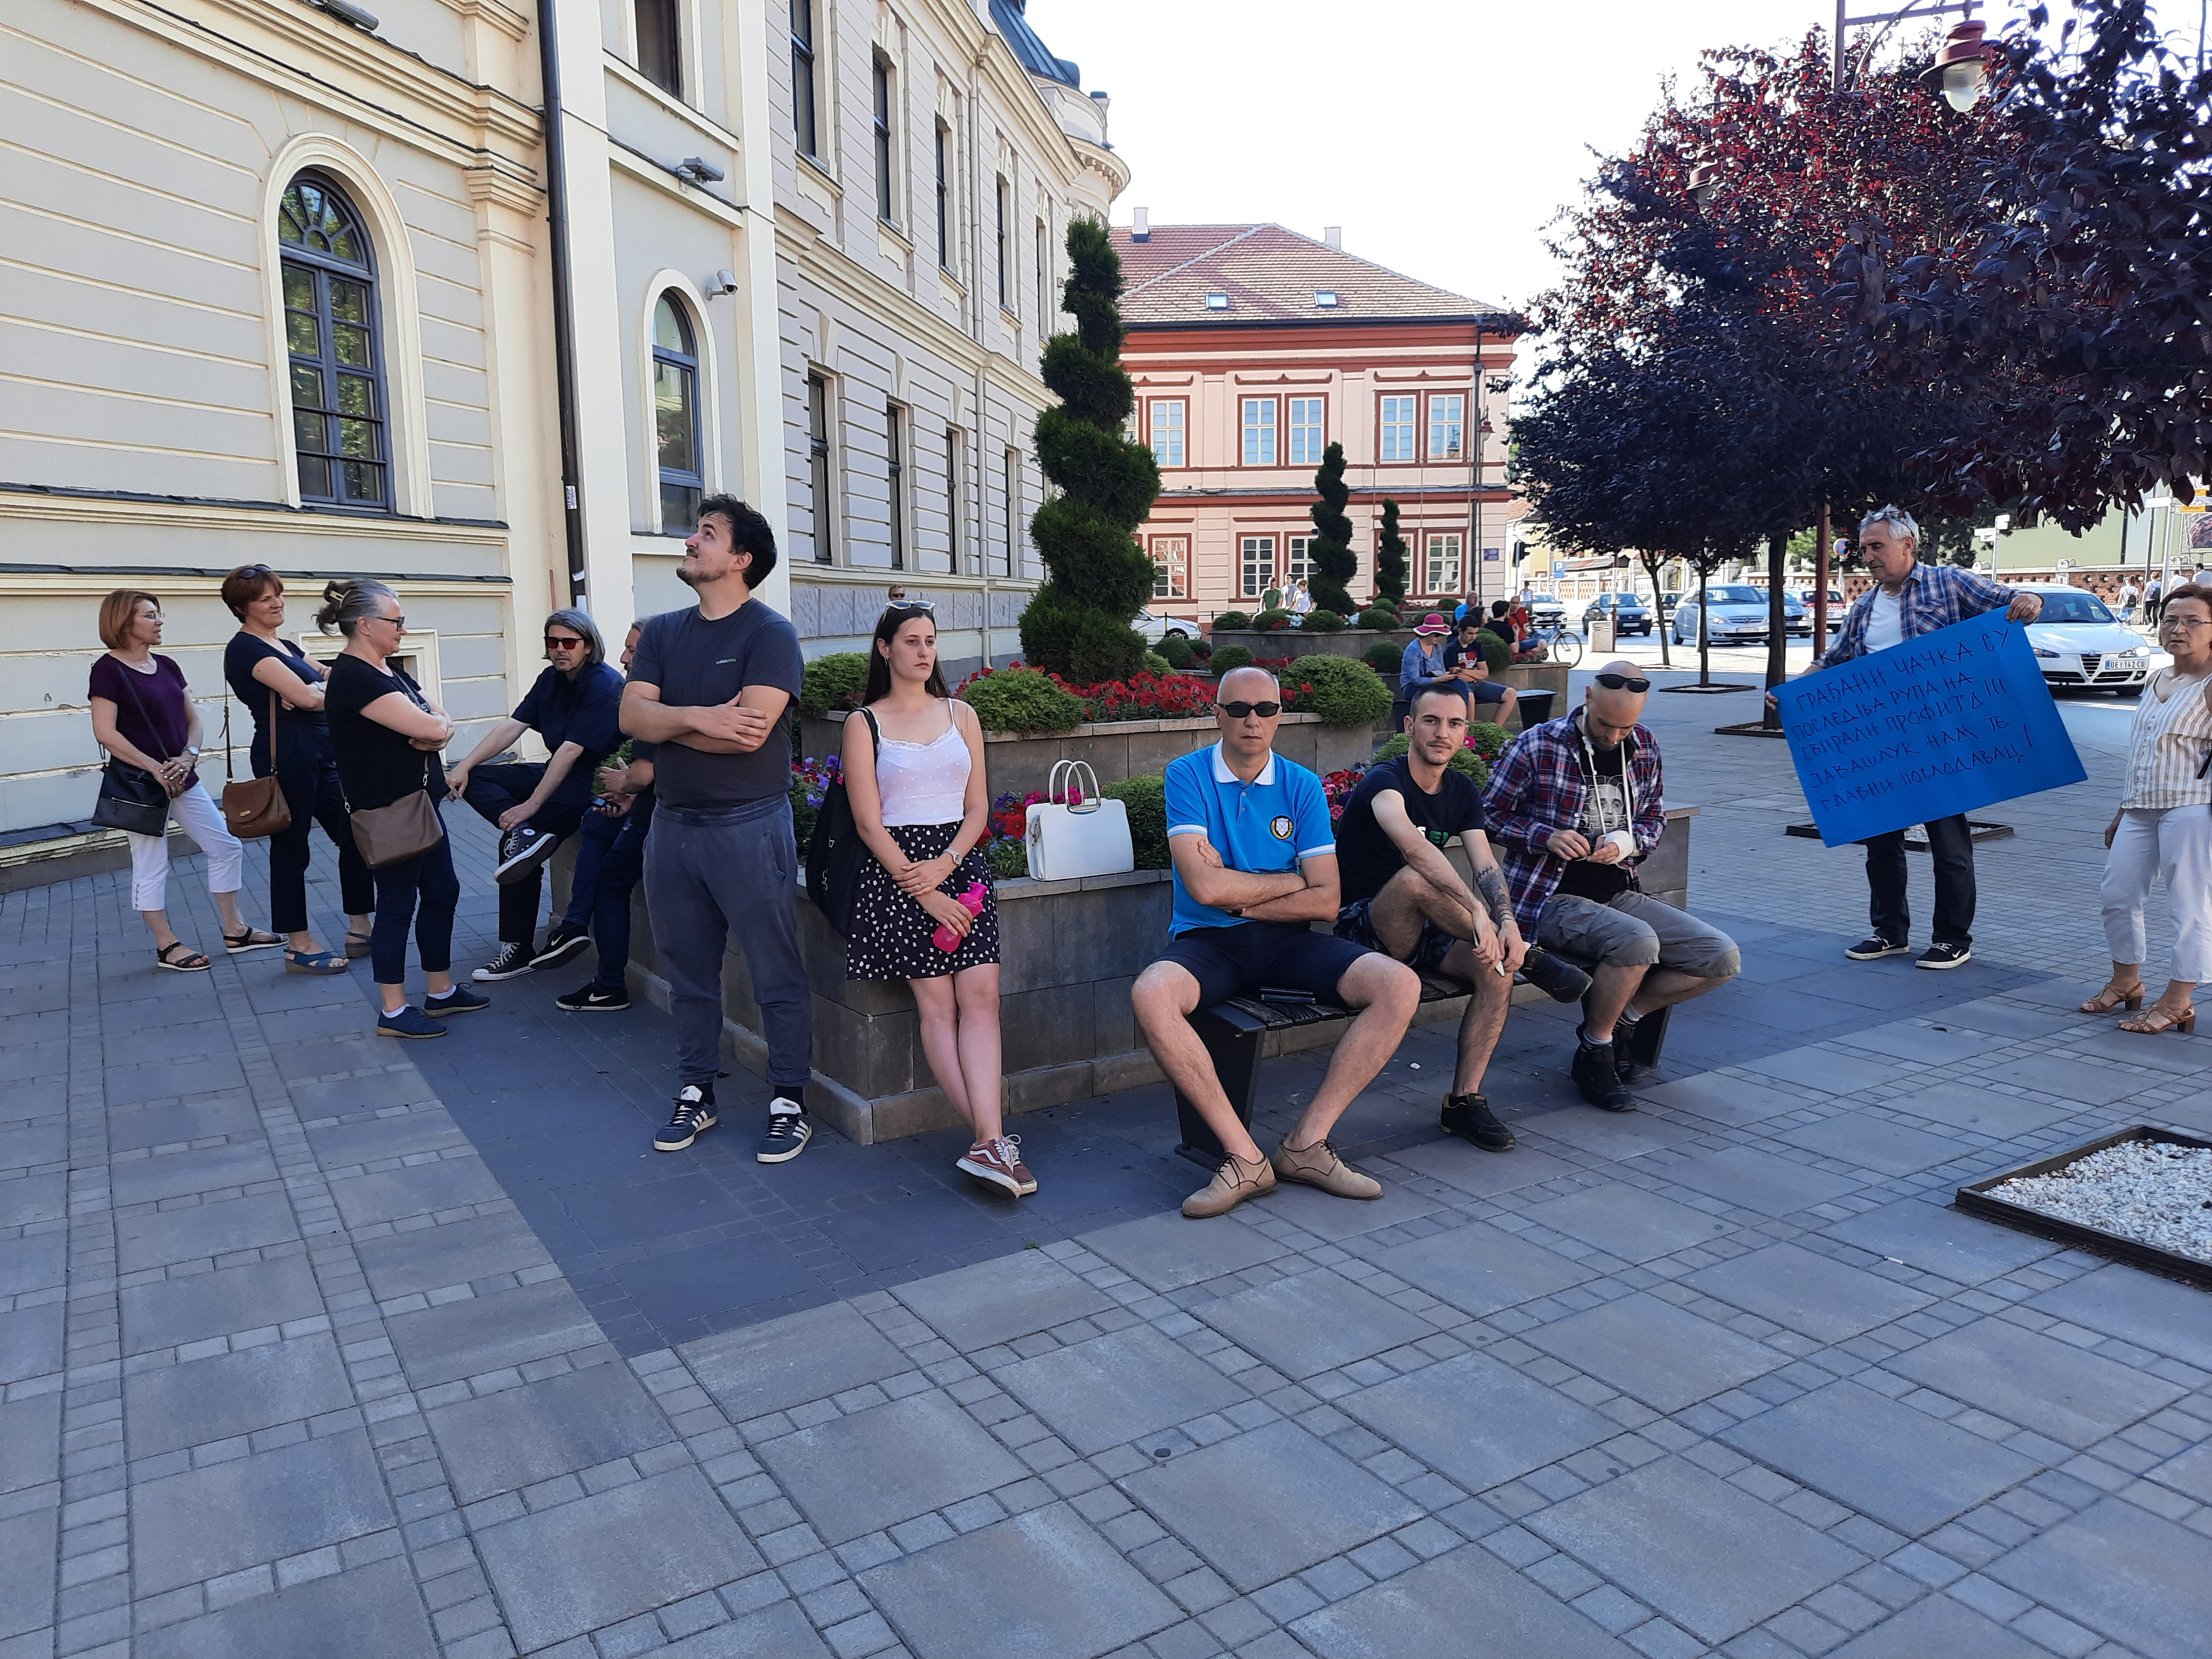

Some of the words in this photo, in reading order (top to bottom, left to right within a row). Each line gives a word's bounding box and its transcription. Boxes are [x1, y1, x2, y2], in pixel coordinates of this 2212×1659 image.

[1893, 642, 1974, 675] ЧАЧКА
[1981, 628, 2009, 651] СУ
[1890, 681, 1939, 706] РУПА
[1943, 672, 1973, 691] НА
[1926, 724, 1979, 748] НАМ
